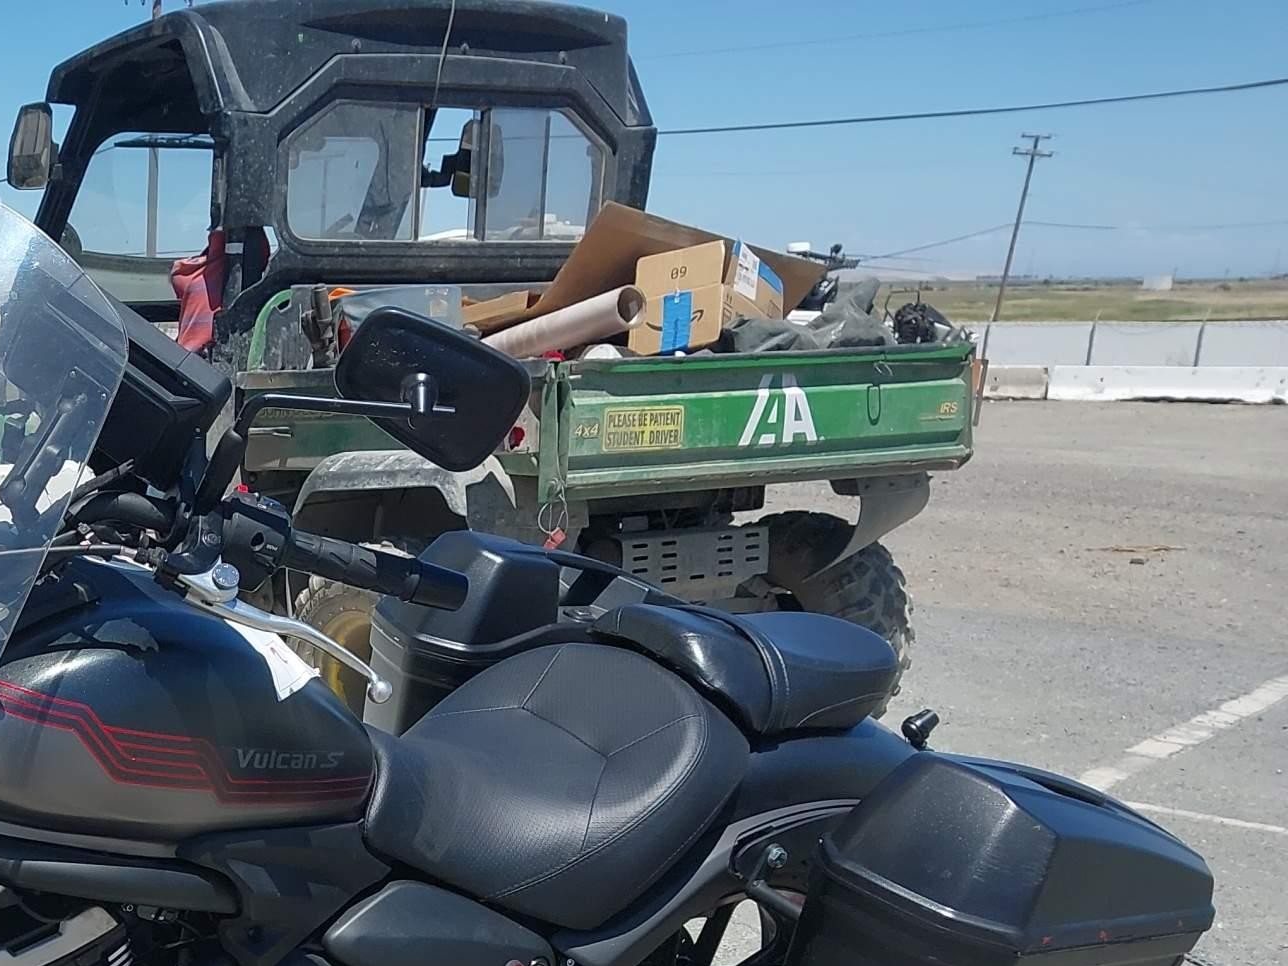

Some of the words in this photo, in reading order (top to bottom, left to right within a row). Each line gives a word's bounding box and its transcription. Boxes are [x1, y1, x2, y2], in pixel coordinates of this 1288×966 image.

[608, 412, 636, 428] PLEASE
[638, 411, 648, 427] BE
[649, 411, 681, 427] PATIENT
[607, 430, 645, 447] STUDENT
[649, 429, 680, 445] DRIVER
[235, 748, 317, 769] Vulcan
[320, 751, 344, 768] S
